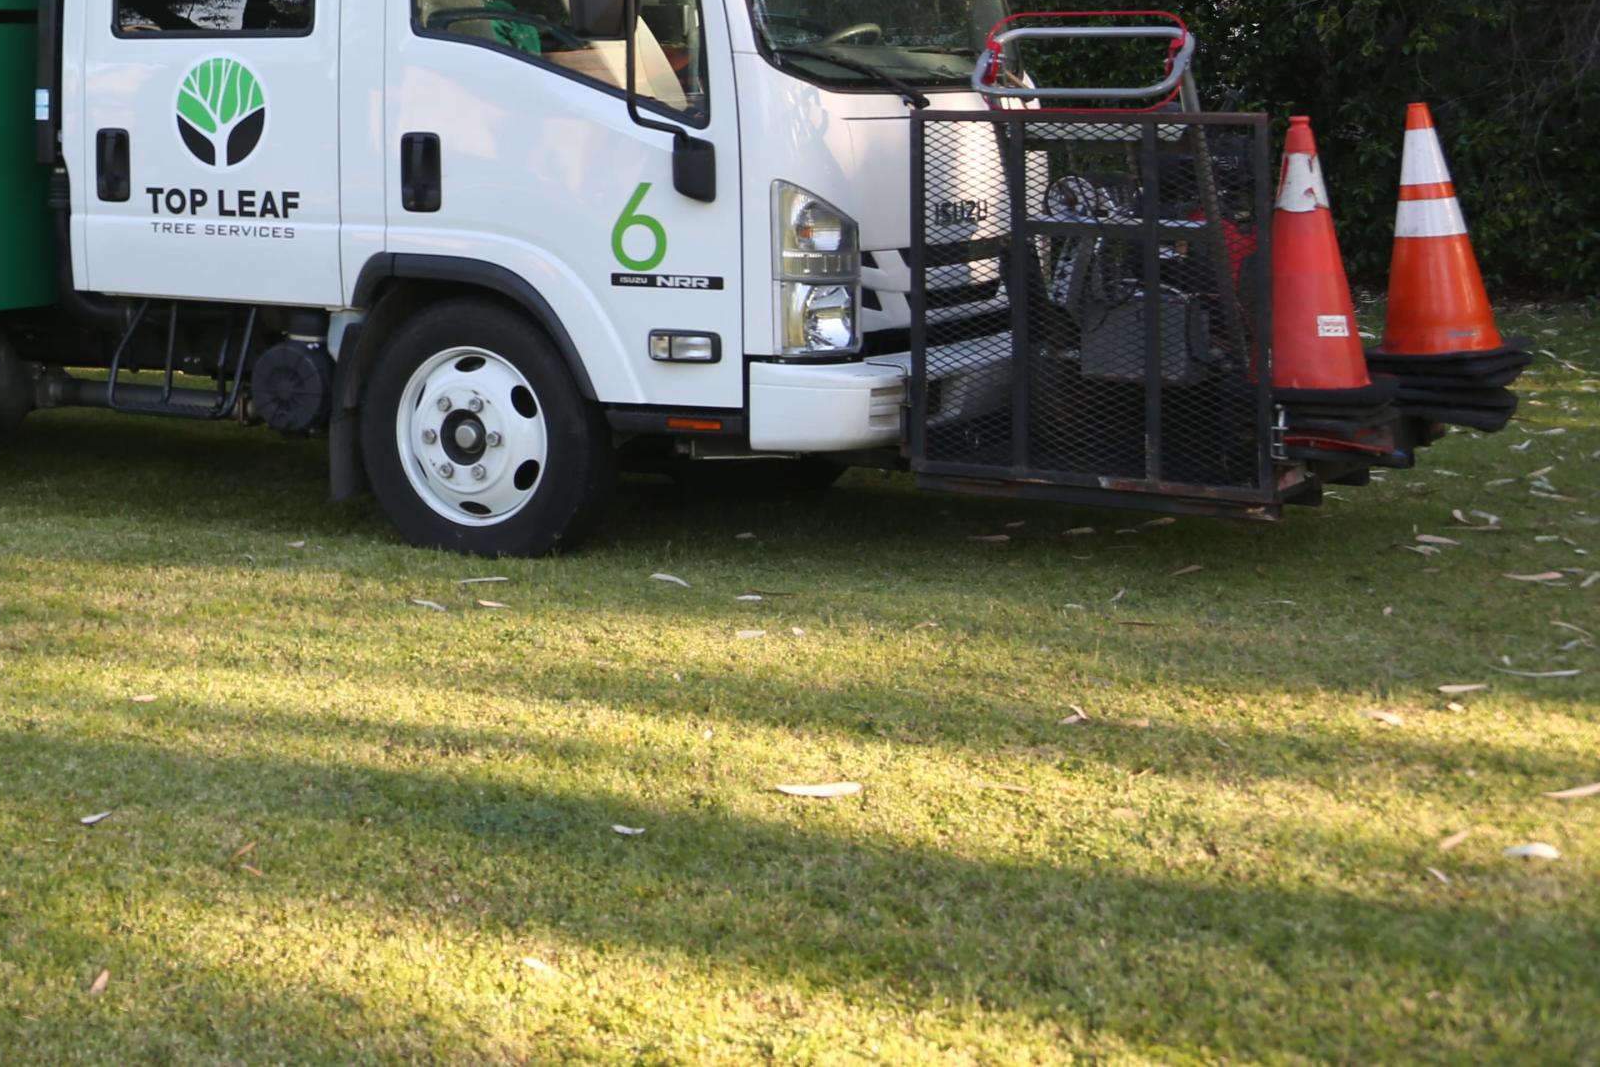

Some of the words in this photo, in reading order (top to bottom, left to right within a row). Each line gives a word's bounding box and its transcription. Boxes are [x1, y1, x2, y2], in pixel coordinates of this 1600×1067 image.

[145, 187, 208, 215] TOP
[217, 189, 300, 219] LEAF
[150, 222, 196, 235] TREE
[204, 224, 296, 239] SERVICES
[611, 181, 667, 272] 6
[619, 276, 648, 285] ISUZU
[655, 275, 710, 289] NRR
